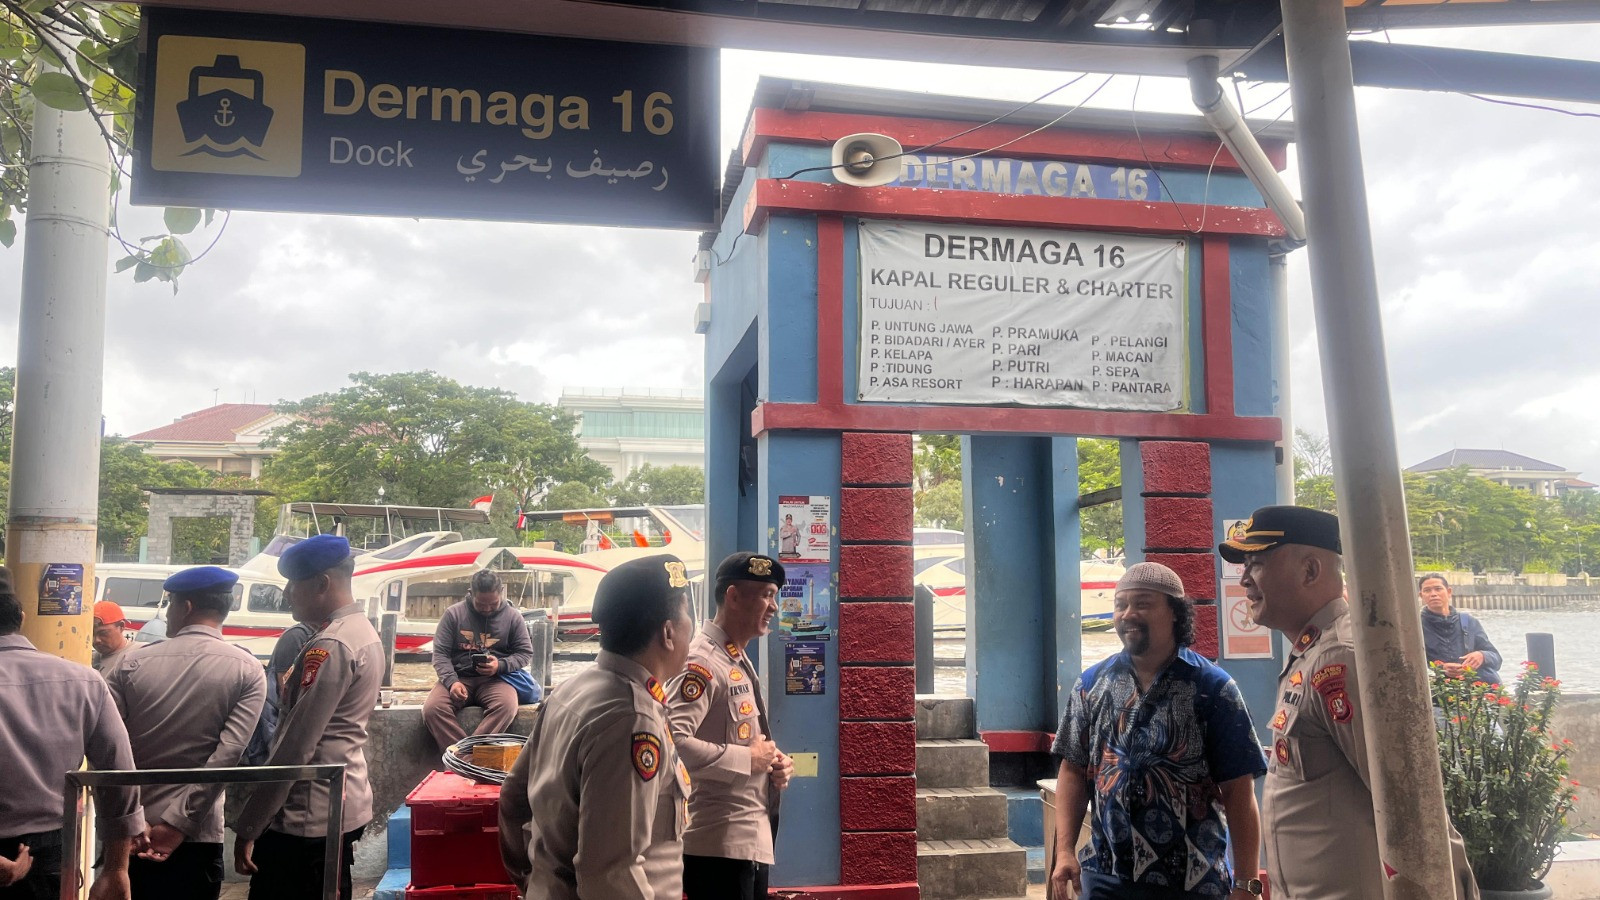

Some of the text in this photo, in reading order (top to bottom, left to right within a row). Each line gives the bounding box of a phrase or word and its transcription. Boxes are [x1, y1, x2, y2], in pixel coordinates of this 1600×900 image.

[323, 69, 675, 140] Dermaga 16
[329, 136, 414, 168] Dock
[456, 149, 668, 191] رصيف بحري
[900, 154, 1149, 200] DERMAGA 16
[924, 233, 1126, 269] DERMAGA 16
[871, 268, 1173, 300] KAPAL REGULER & CHARTER
[870, 297, 922, 310] TUJUAN
[871, 320, 973, 334] P. UNTUNG JAWA
[992, 326, 1079, 341] P. PRAMUKA
[871, 334, 880, 344] P.
[884, 335, 943, 347] BIDADARI
[953, 338, 985, 348] AYER
[1110, 335, 1168, 348] PELANGI
[871, 348, 933, 360] P. KELAPA
[992, 343, 1041, 356] P. PARI
[1092, 351, 1153, 363] P. MACAN
[992, 360, 1049, 373] P. PUTRI
[1092, 366, 1140, 378] P. SEPA
[870, 376, 962, 389] P. ASA RESORT
[1013, 377, 1083, 391] HARAPAN
[1112, 381, 1171, 394] PANTARA
